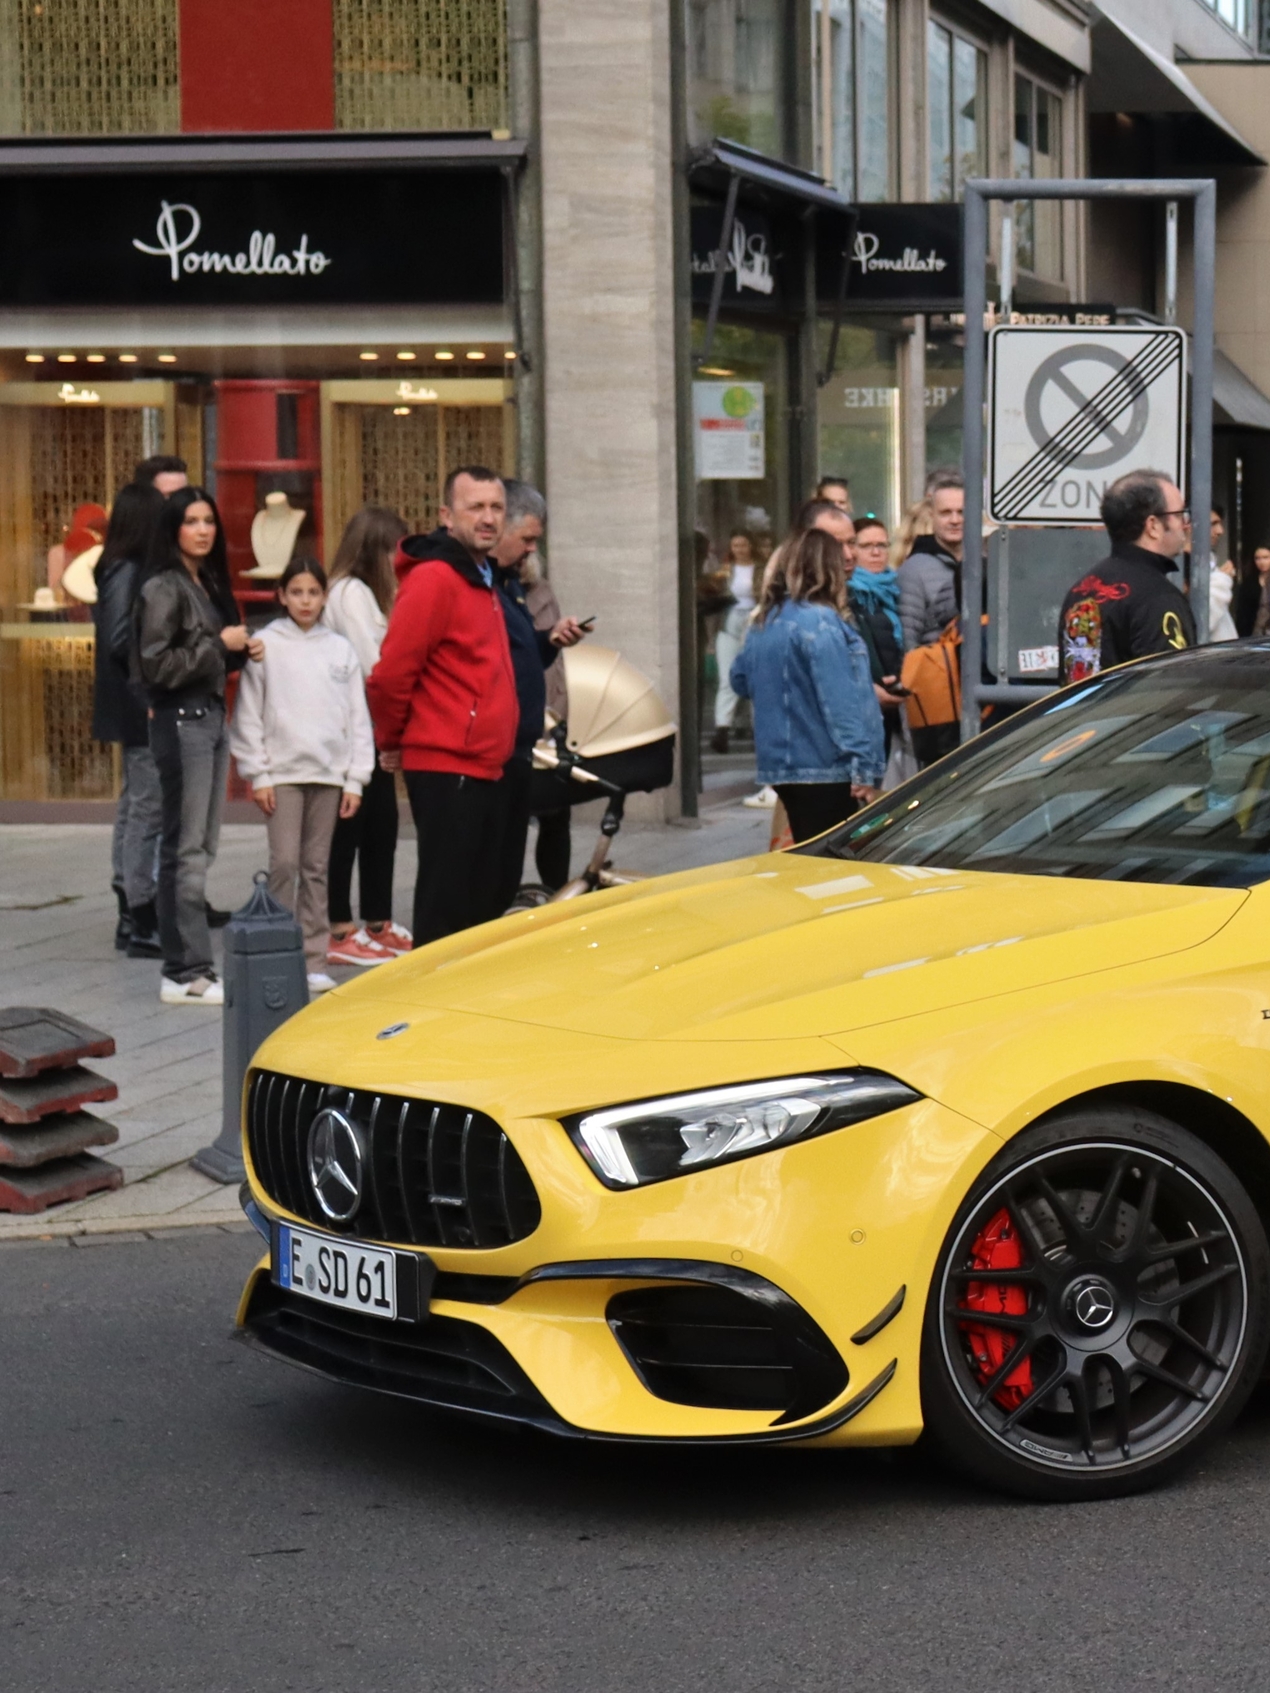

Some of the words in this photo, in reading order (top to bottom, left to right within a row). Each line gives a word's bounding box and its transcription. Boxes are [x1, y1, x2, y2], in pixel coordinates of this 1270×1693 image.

[132, 200, 331, 281] Pomellato
[850, 231, 947, 274] Pomellato
[1039, 479, 1108, 509] ZON
[290, 1236, 304, 1287] E
[318, 1246, 349, 1299] SD
[356, 1255, 391, 1310] 61
